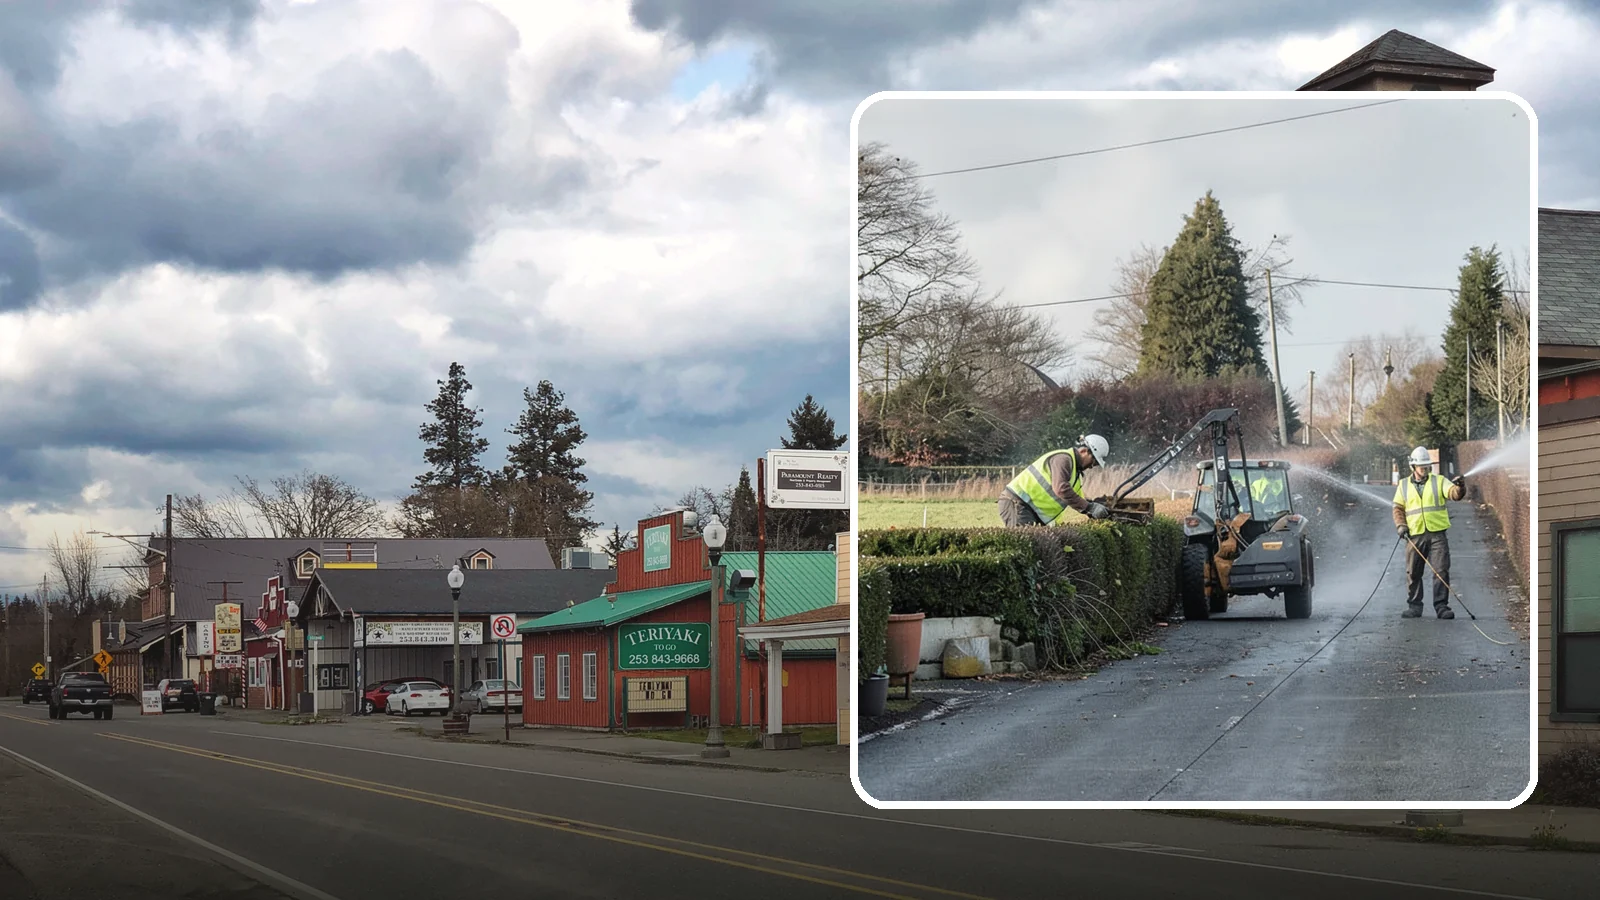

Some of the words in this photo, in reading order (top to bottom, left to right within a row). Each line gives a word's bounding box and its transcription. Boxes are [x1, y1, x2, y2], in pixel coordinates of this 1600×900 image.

[625, 628, 702, 646] TERIYAKI
[629, 654, 649, 664] 253
[651, 653, 700, 664] 843-9668
[639, 681, 672, 690] TERIYAKI
